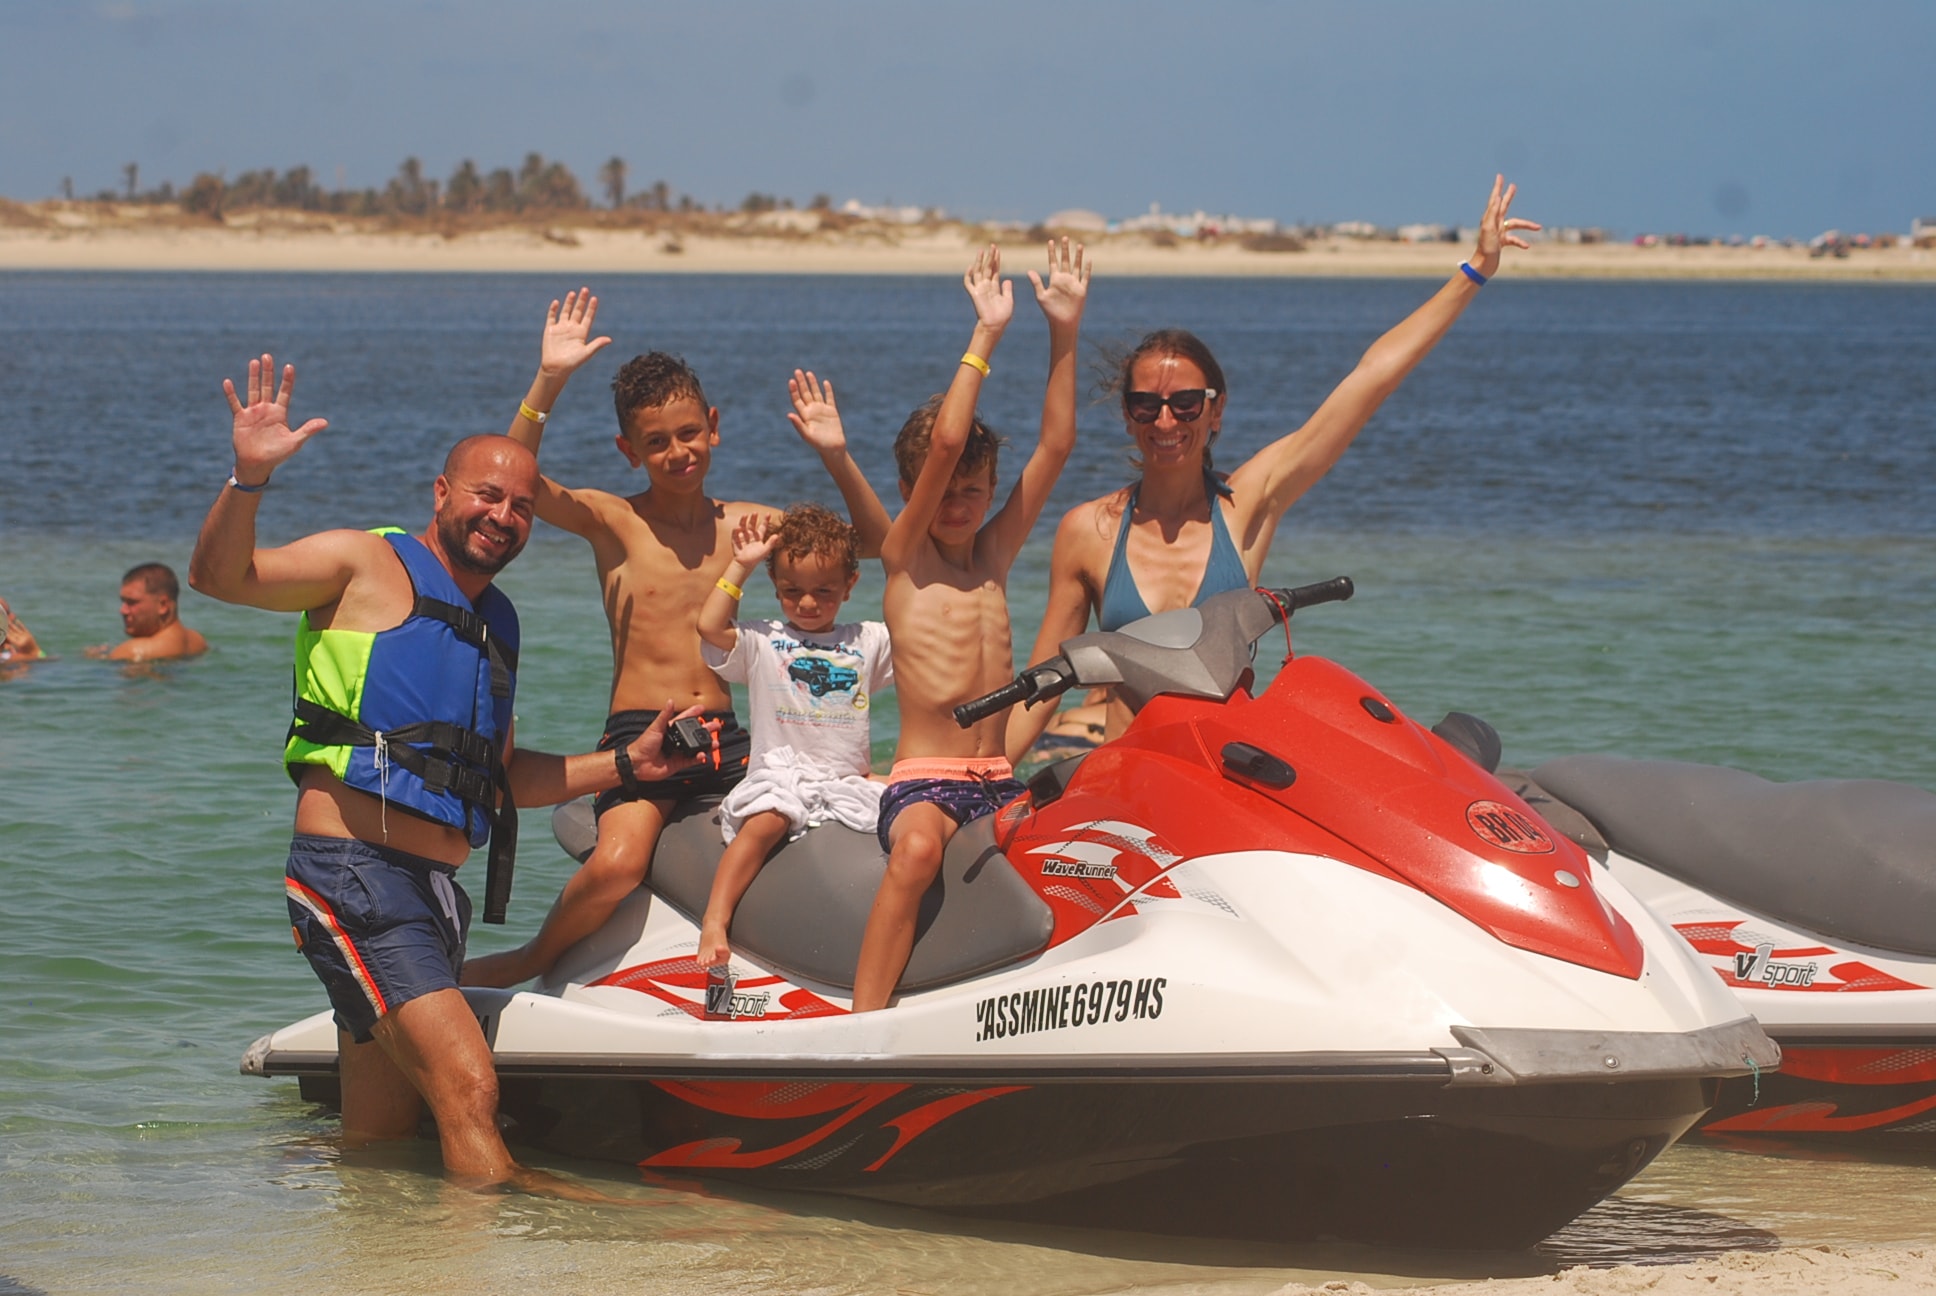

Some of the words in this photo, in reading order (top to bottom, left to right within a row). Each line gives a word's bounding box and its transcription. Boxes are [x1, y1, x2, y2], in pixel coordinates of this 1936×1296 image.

[1042, 859, 1117, 879] WaveRunner
[1762, 962, 1818, 988] sport
[728, 992, 770, 1018] sport
